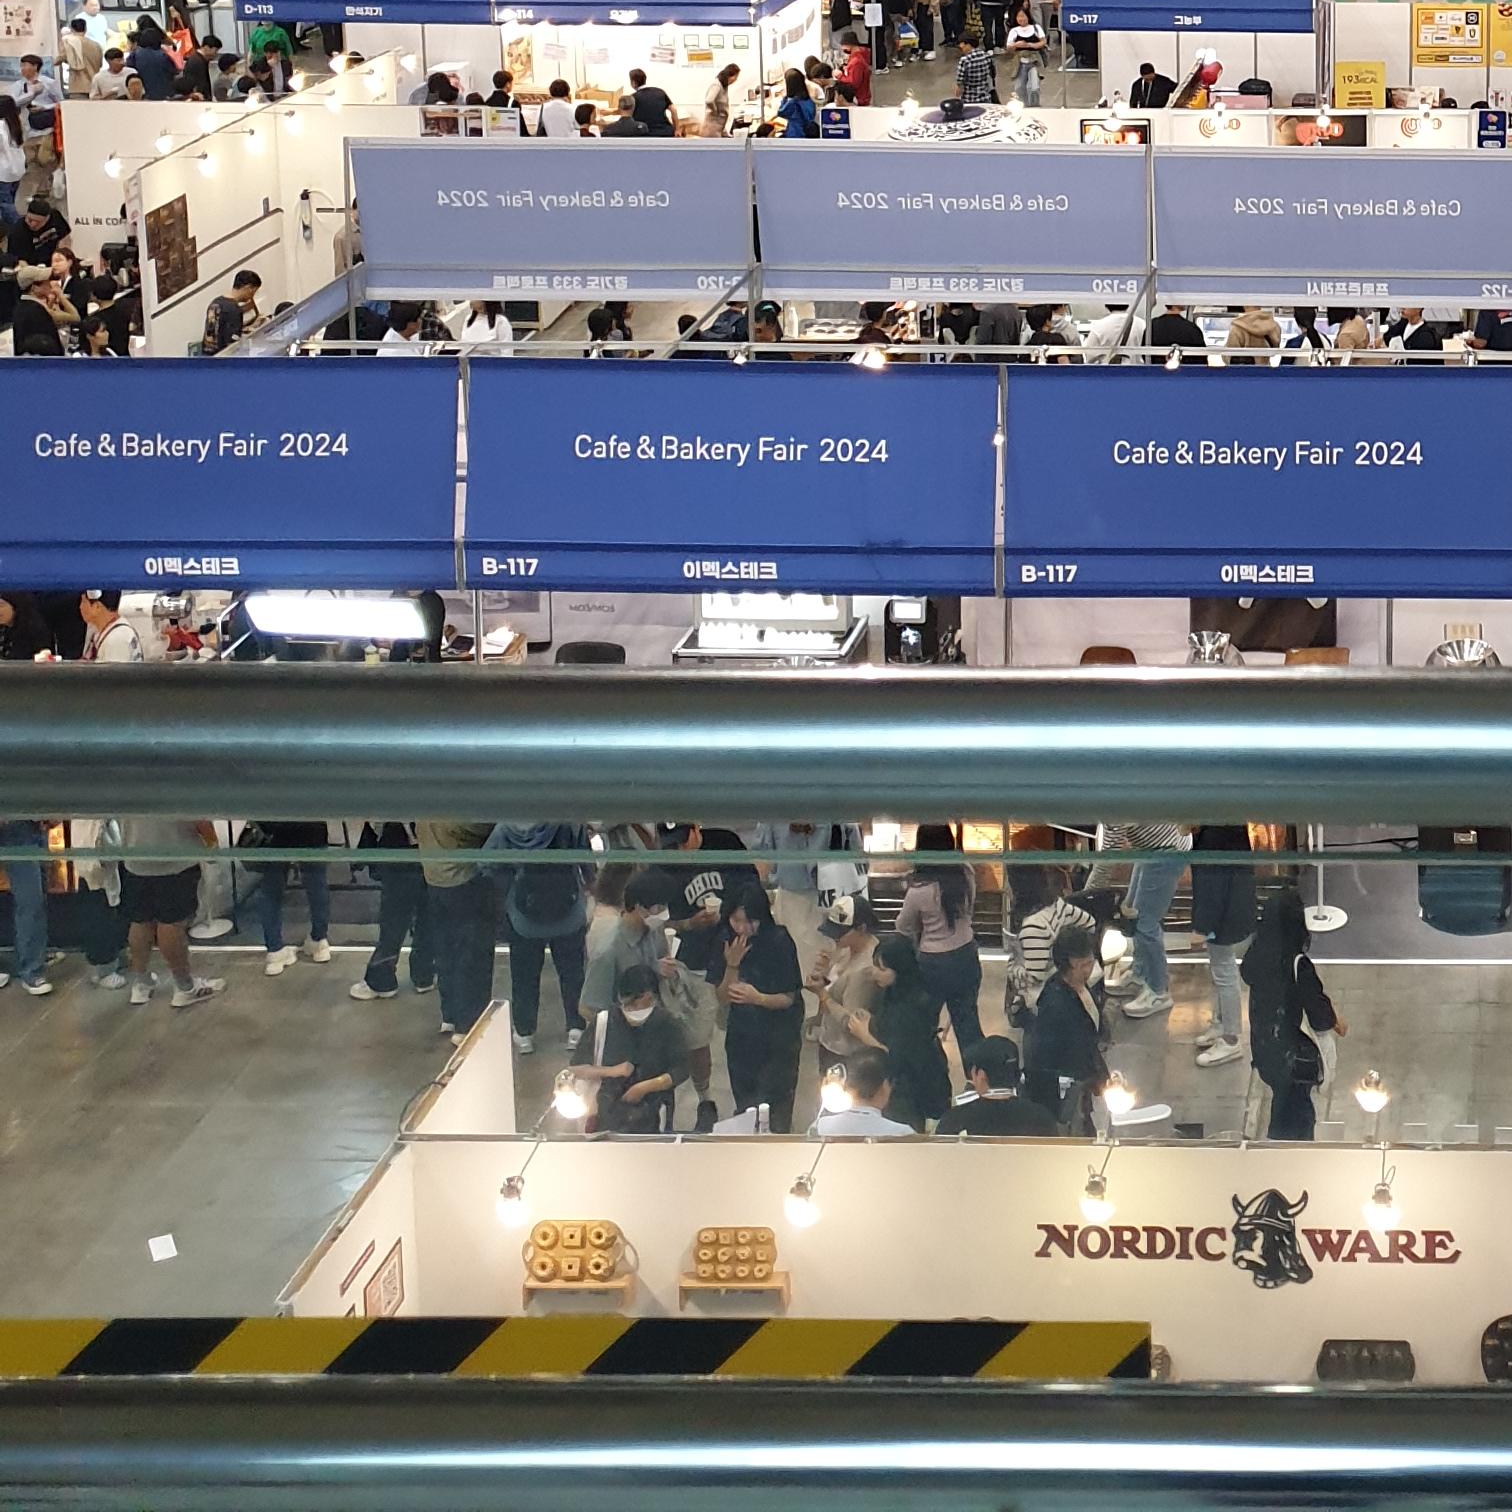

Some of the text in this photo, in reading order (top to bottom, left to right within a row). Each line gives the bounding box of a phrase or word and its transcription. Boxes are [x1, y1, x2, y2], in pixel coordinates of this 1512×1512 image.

[244, 4, 274, 15] D-113
[1069, 13, 1098, 25] D-117
[74, 217, 90, 226] ALL
[34, 432, 349, 464] Cafe & Bakery Fair 2024
[574, 434, 889, 467] Cafe & Bakery Fair 2024
[1113, 439, 1424, 471] Cafe & Bakery Fair 2024
[144, 557, 240, 576] 이멕스테크
[482, 557, 778, 581] B-117 이멕스테크
[1021, 565, 1315, 584] B-117 이멕스테크
[684, 870, 724, 906] OHIO
[1034, 1223, 1462, 1265] NORDIC WARE
